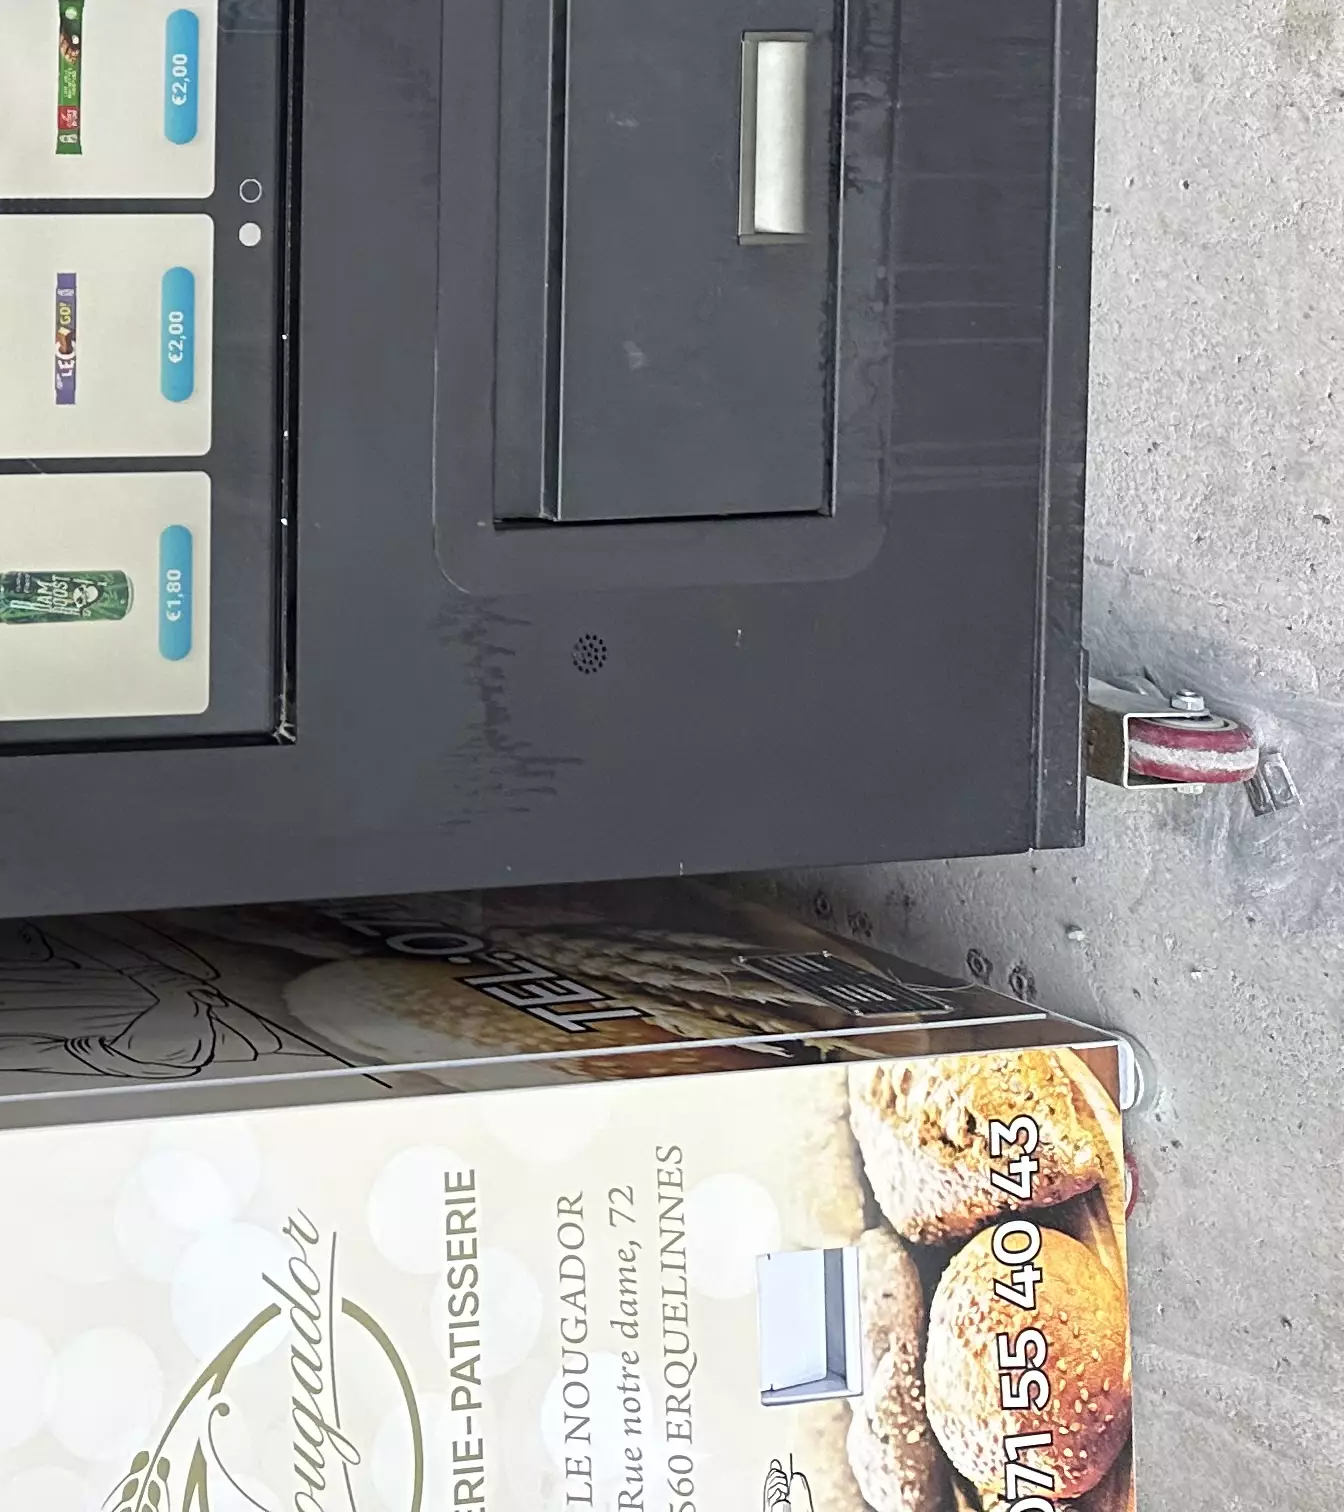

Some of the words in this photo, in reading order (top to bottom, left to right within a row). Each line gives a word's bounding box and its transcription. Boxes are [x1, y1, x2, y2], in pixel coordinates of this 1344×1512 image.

[171, 53, 190, 106] €2,00
[167, 311, 185, 363] €2,00
[165, 569, 184, 622] €1,80
[988, 1114, 1040, 1199] 43
[607, 1185, 637, 1228] 72
[610, 1239, 642, 1340] dame,
[655, 1144, 698, 1445] ERQUELINNES
[990, 1220, 1043, 1308] 40
[443, 1168, 485, 1512] RIE-PATISSERIE
[556, 1191, 593, 1445] NOUGADOR
[613, 1350, 643, 1436] notre
[996, 1327, 1051, 1411] 55
[565, 1456, 595, 1507] LE
[616, 1446, 645, 1512] Rue
